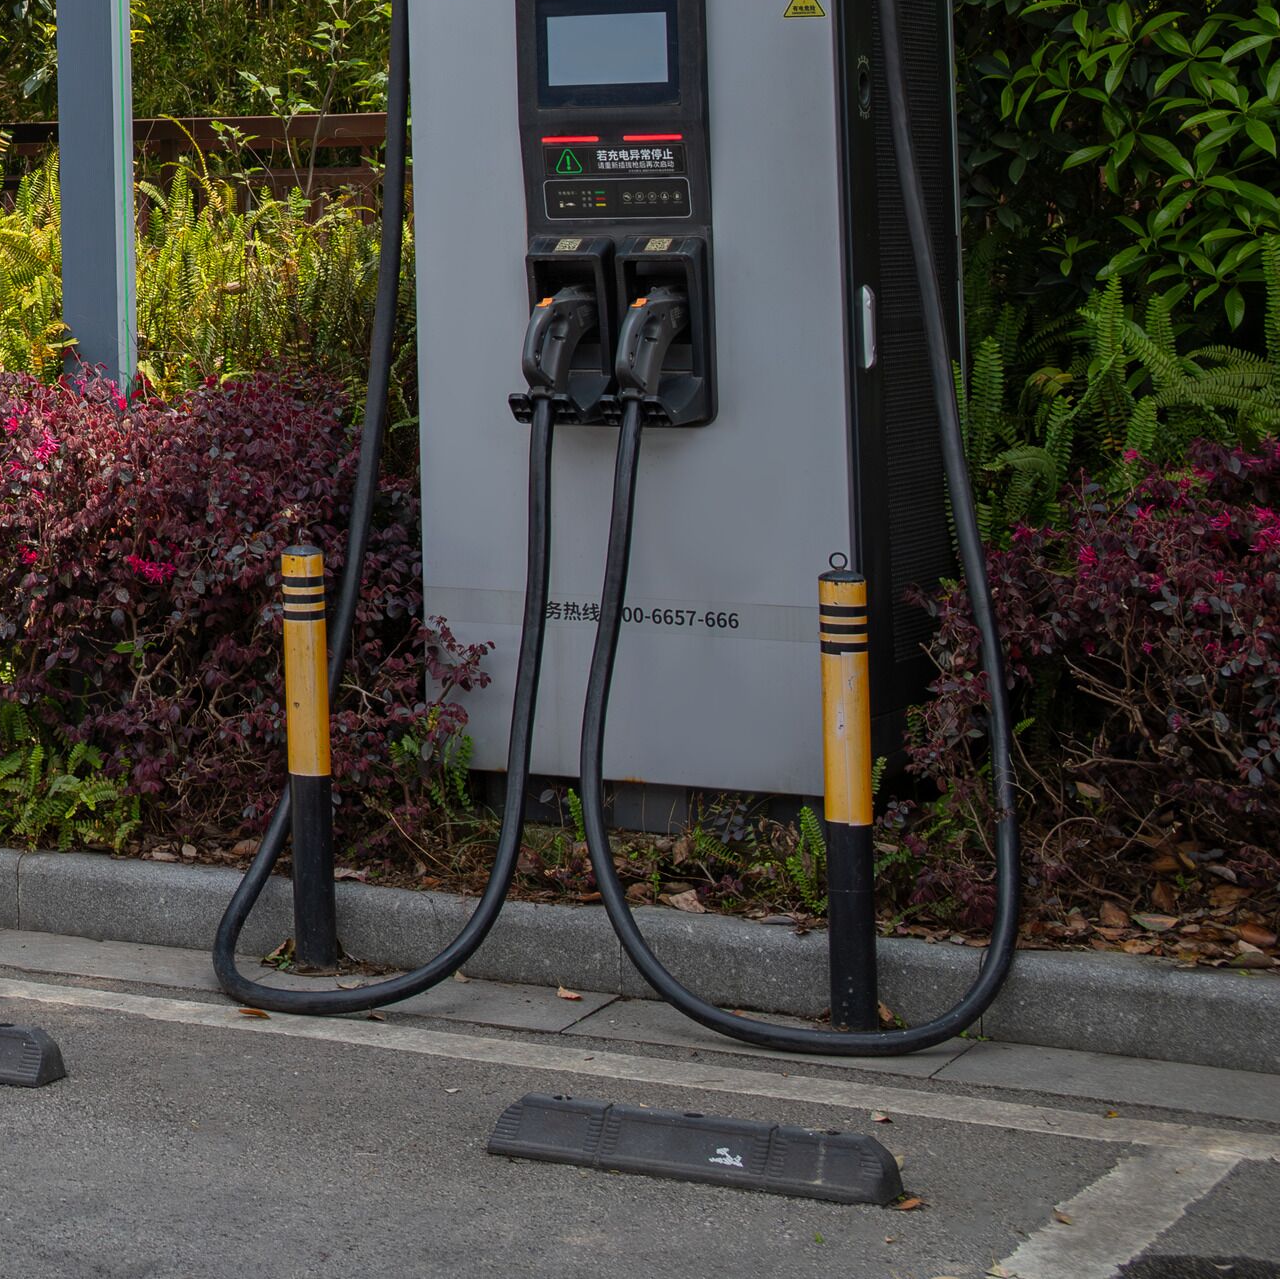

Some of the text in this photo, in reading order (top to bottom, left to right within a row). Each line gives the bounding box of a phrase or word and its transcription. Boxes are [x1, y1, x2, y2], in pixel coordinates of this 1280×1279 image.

[596, 148, 674, 161] 若充电异常停止
